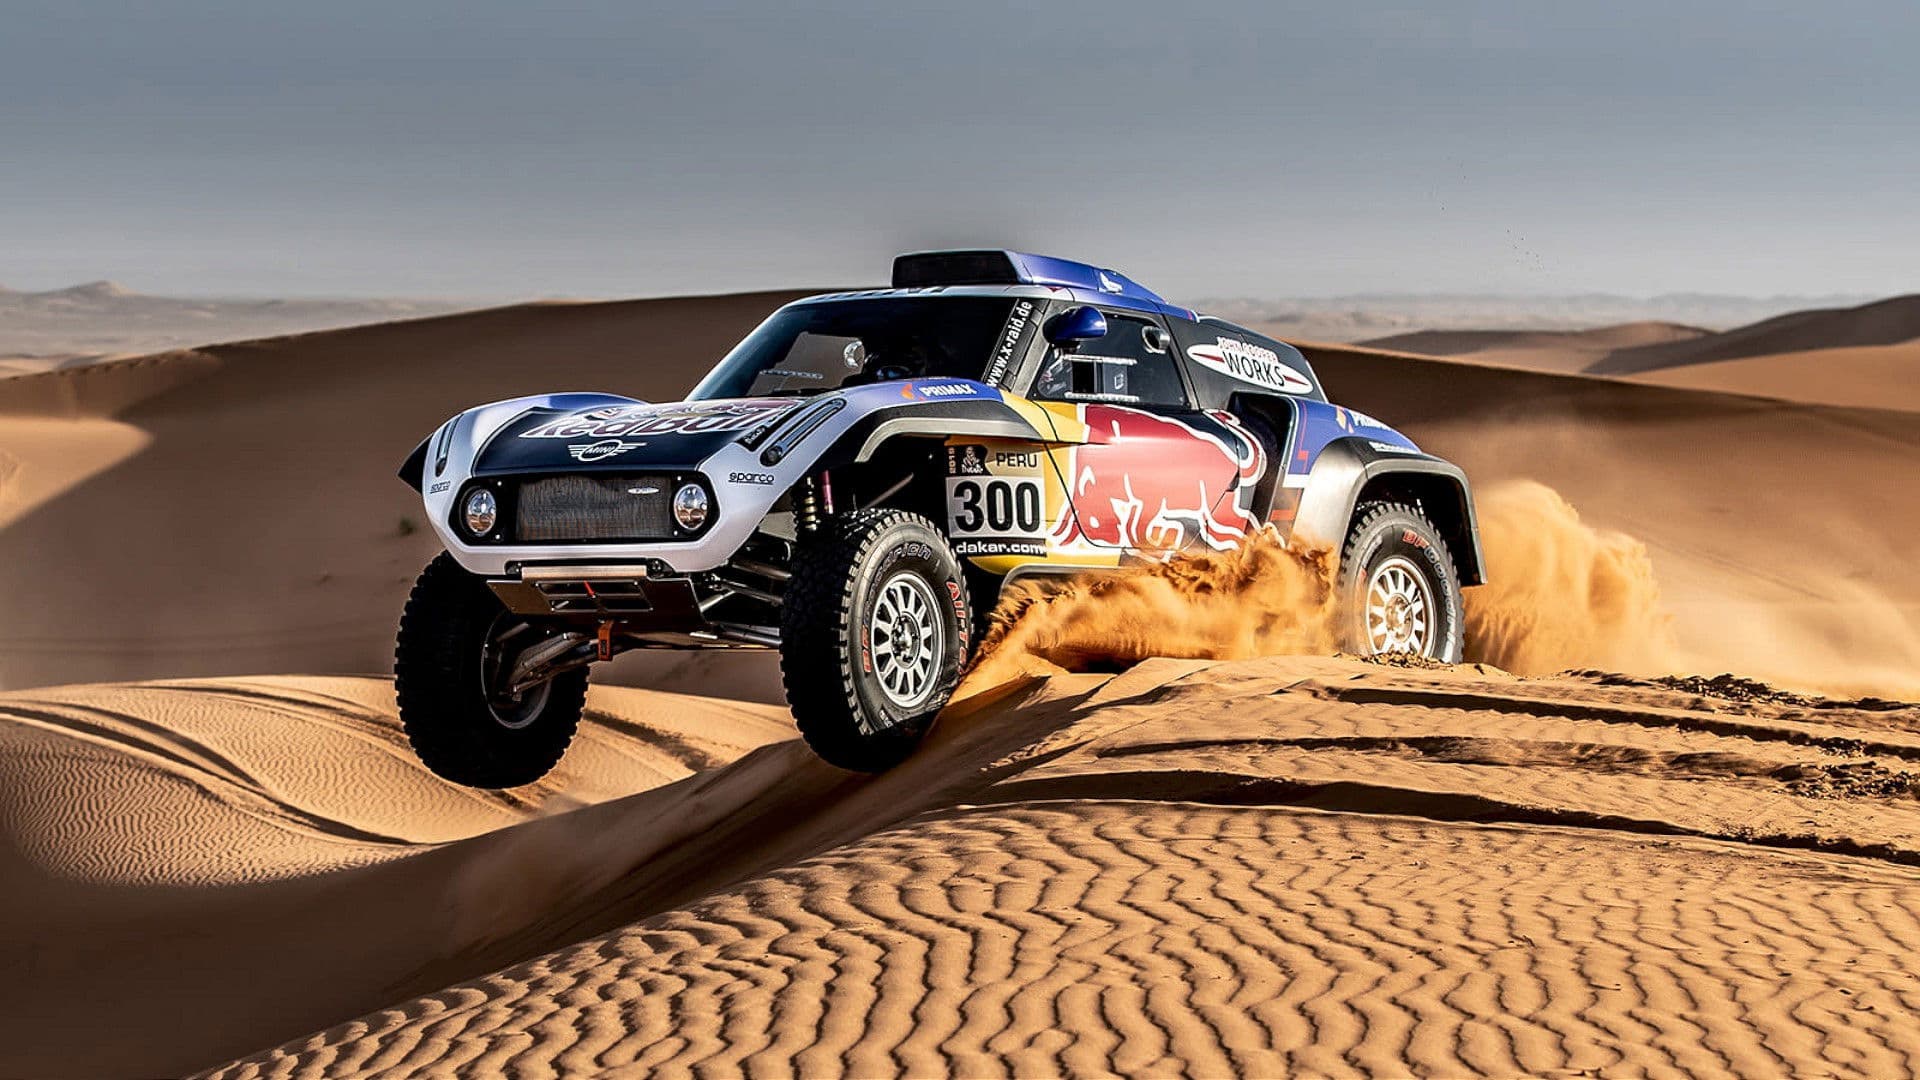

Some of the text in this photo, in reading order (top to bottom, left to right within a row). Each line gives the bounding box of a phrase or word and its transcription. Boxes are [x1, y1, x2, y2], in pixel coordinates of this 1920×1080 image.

[987, 301, 1033, 387] www.x-raid.de
[1222, 351, 1285, 387] WORKS
[919, 383, 977, 397] PRIMAX
[996, 452, 1037, 468] PERU
[728, 472, 775, 484] sparco
[953, 480, 1040, 533] 300
[956, 541, 1045, 555] dakar.com
